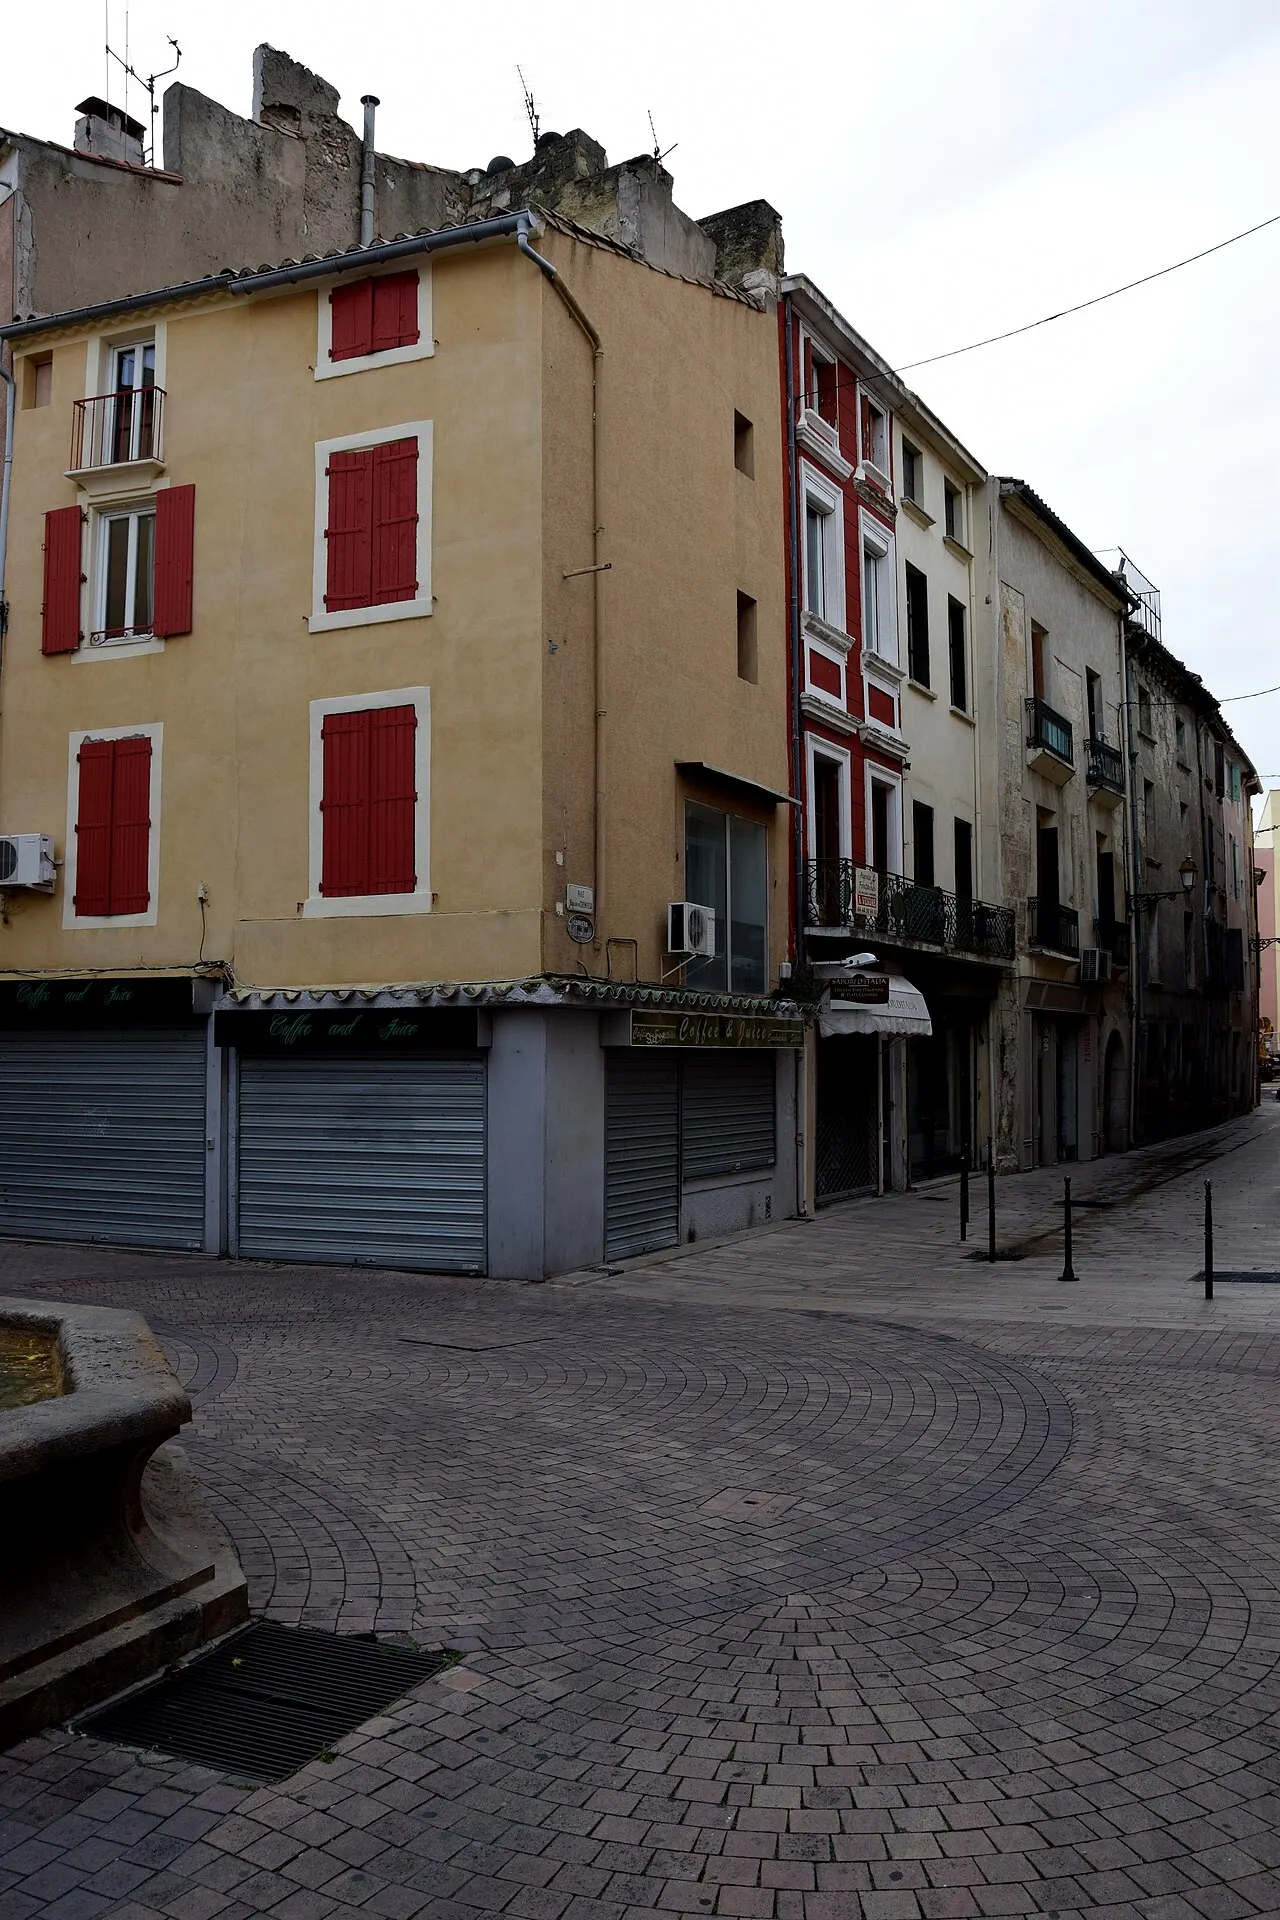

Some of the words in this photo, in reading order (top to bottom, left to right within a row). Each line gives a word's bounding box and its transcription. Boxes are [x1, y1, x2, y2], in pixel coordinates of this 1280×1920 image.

[16, 981, 51, 1010] Coffee
[65, 981, 93, 1004] and
[104, 984, 136, 1009] Juice
[269, 1013, 313, 1045] Coffee
[328, 1014, 363, 1036] and
[376, 1017, 420, 1042] Juice
[680, 1015, 719, 1045] Coffee
[725, 1019, 733, 1038] &
[738, 1020, 767, 1047] Juice
